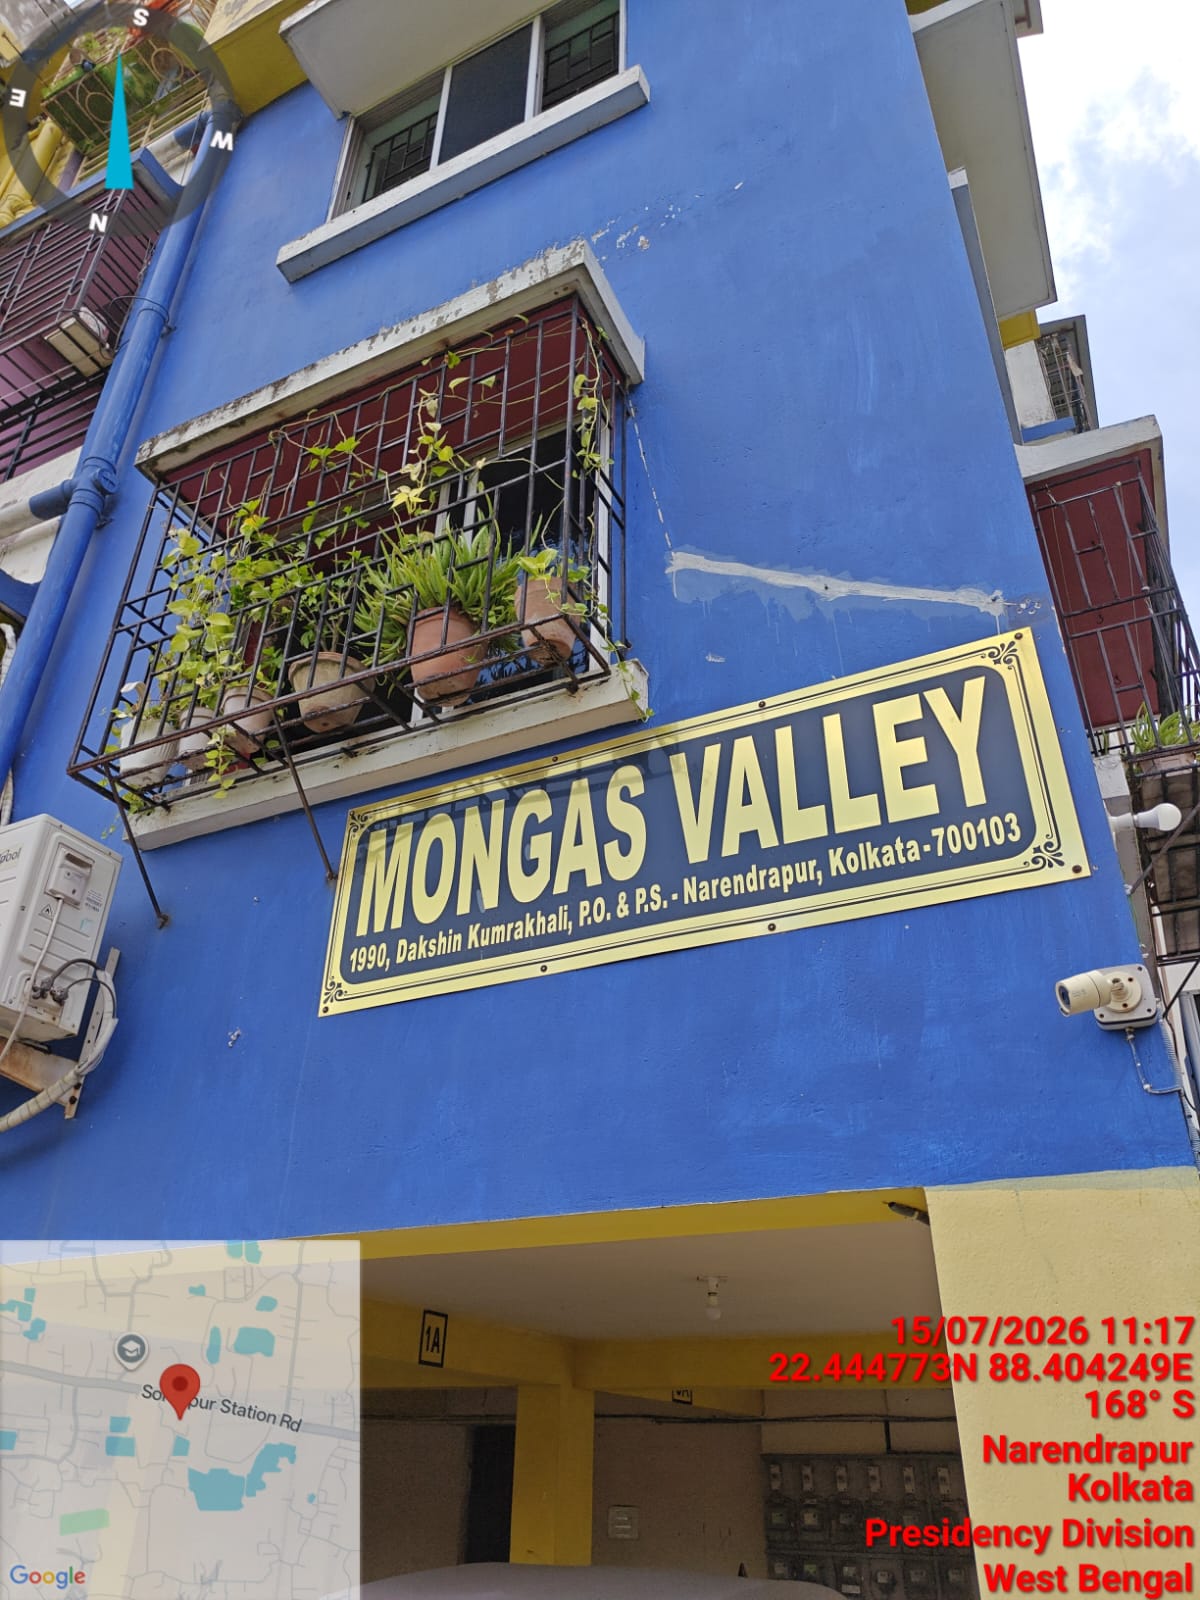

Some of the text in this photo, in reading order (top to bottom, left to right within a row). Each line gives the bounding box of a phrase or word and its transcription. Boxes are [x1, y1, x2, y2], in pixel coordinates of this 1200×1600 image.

[356, 675, 987, 938] MONGAS VALLEY
[350, 946, 391, 973] 1990,
[396, 928, 462, 964] Dakshin
[468, 910, 573, 950] Kumrakhali,
[579, 896, 612, 926] P.O.
[617, 894, 630, 918] &
[635, 883, 668, 914] P.S.
[683, 859, 823, 904] Narendrapur,
[426, 1325, 440, 1354] 1A
